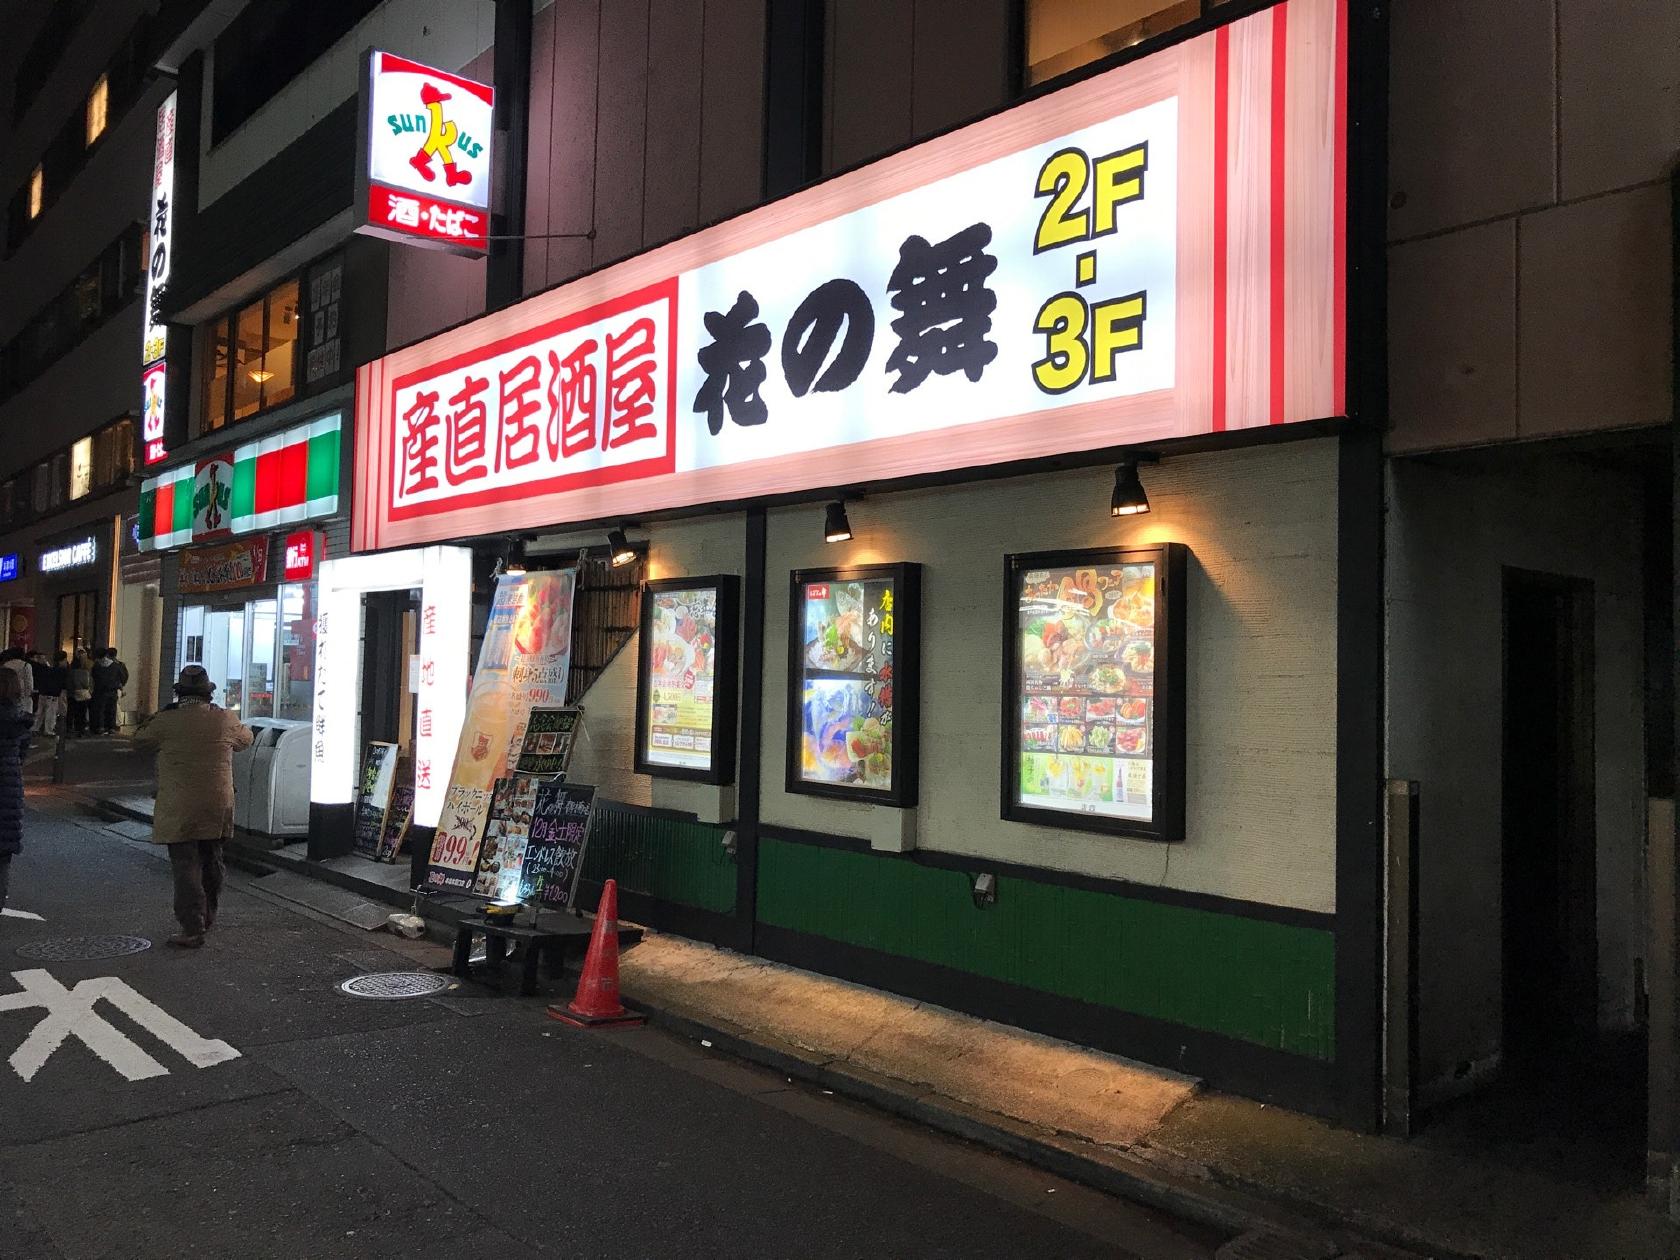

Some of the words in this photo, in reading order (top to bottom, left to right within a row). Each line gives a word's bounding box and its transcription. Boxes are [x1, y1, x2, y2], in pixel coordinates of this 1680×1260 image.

[1033, 140, 1148, 256] 2F
[692, 222, 998, 436] 花の舞
[1031, 289, 1146, 395] 3F
[399, 317, 658, 499] 産直居酒屋
